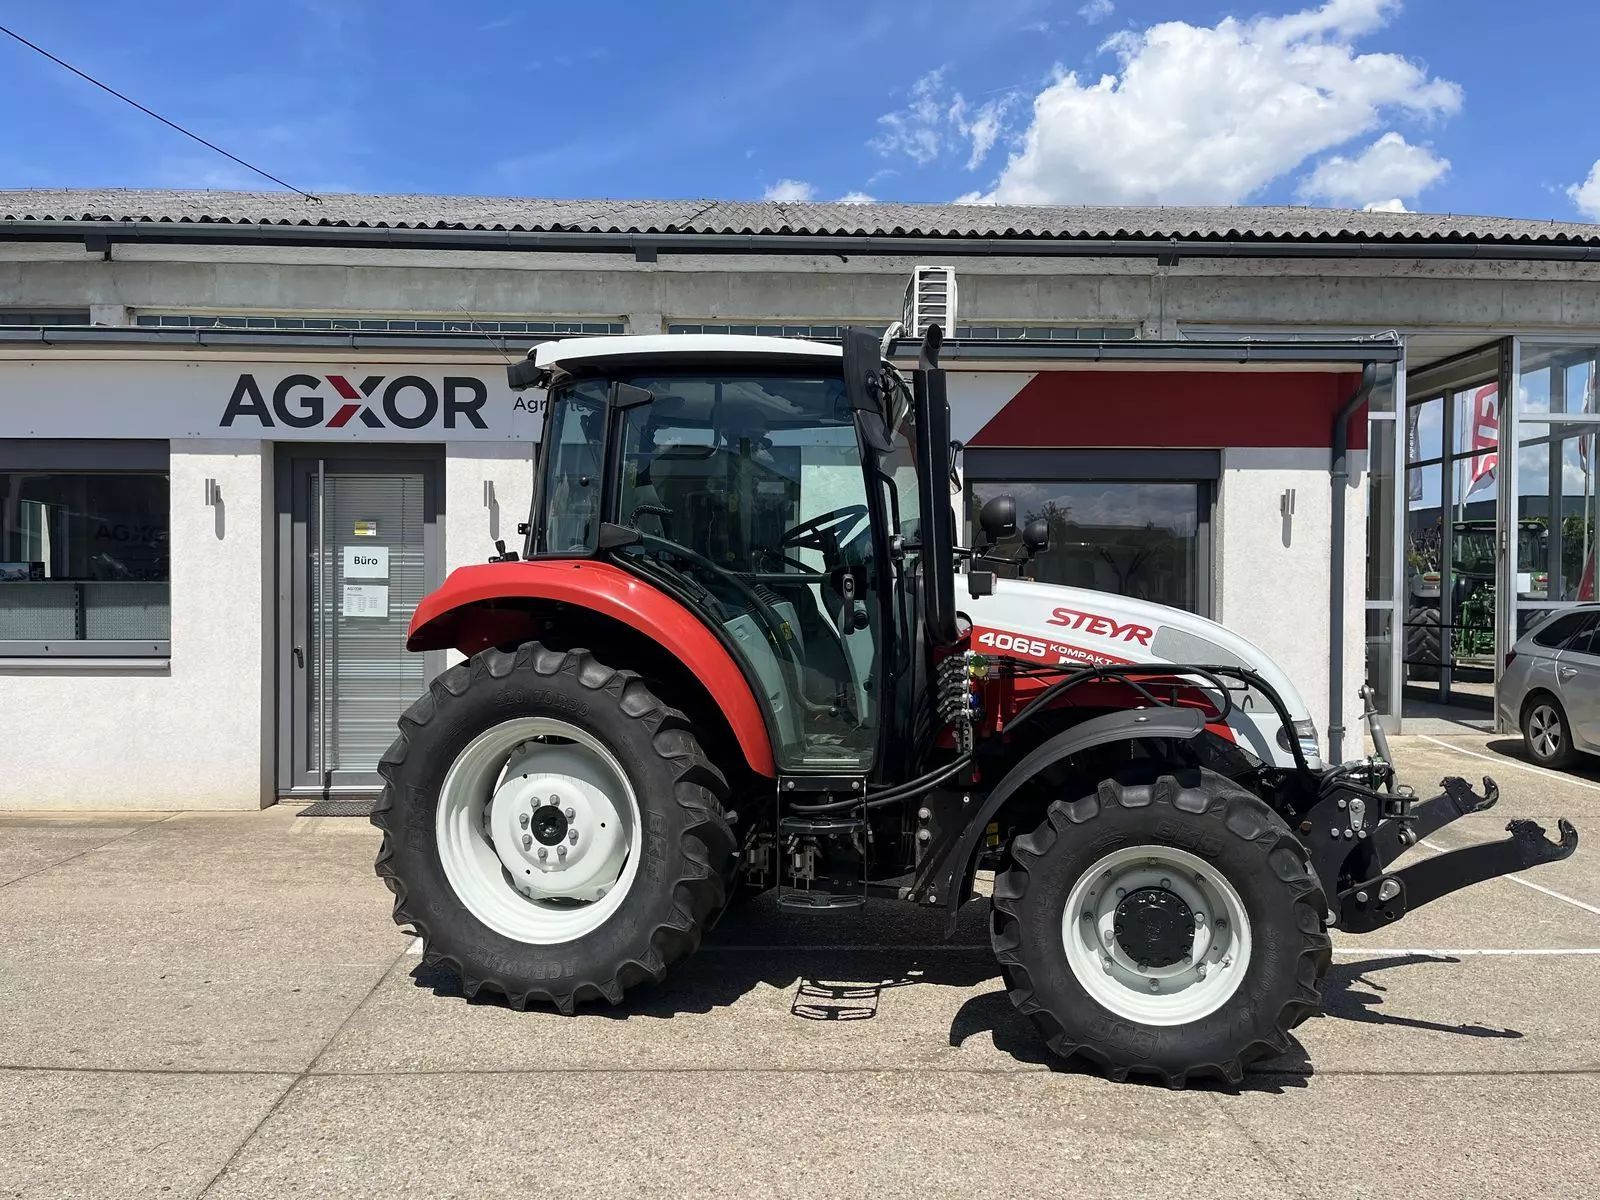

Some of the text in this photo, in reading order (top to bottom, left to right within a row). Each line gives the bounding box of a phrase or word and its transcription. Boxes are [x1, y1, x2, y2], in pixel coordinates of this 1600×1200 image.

[219, 374, 489, 429] AGXOR
[353, 556, 378, 566] Büro
[1046, 607, 1153, 647] STEYR
[978, 632, 1113, 666] 4065 KOMPAKT
